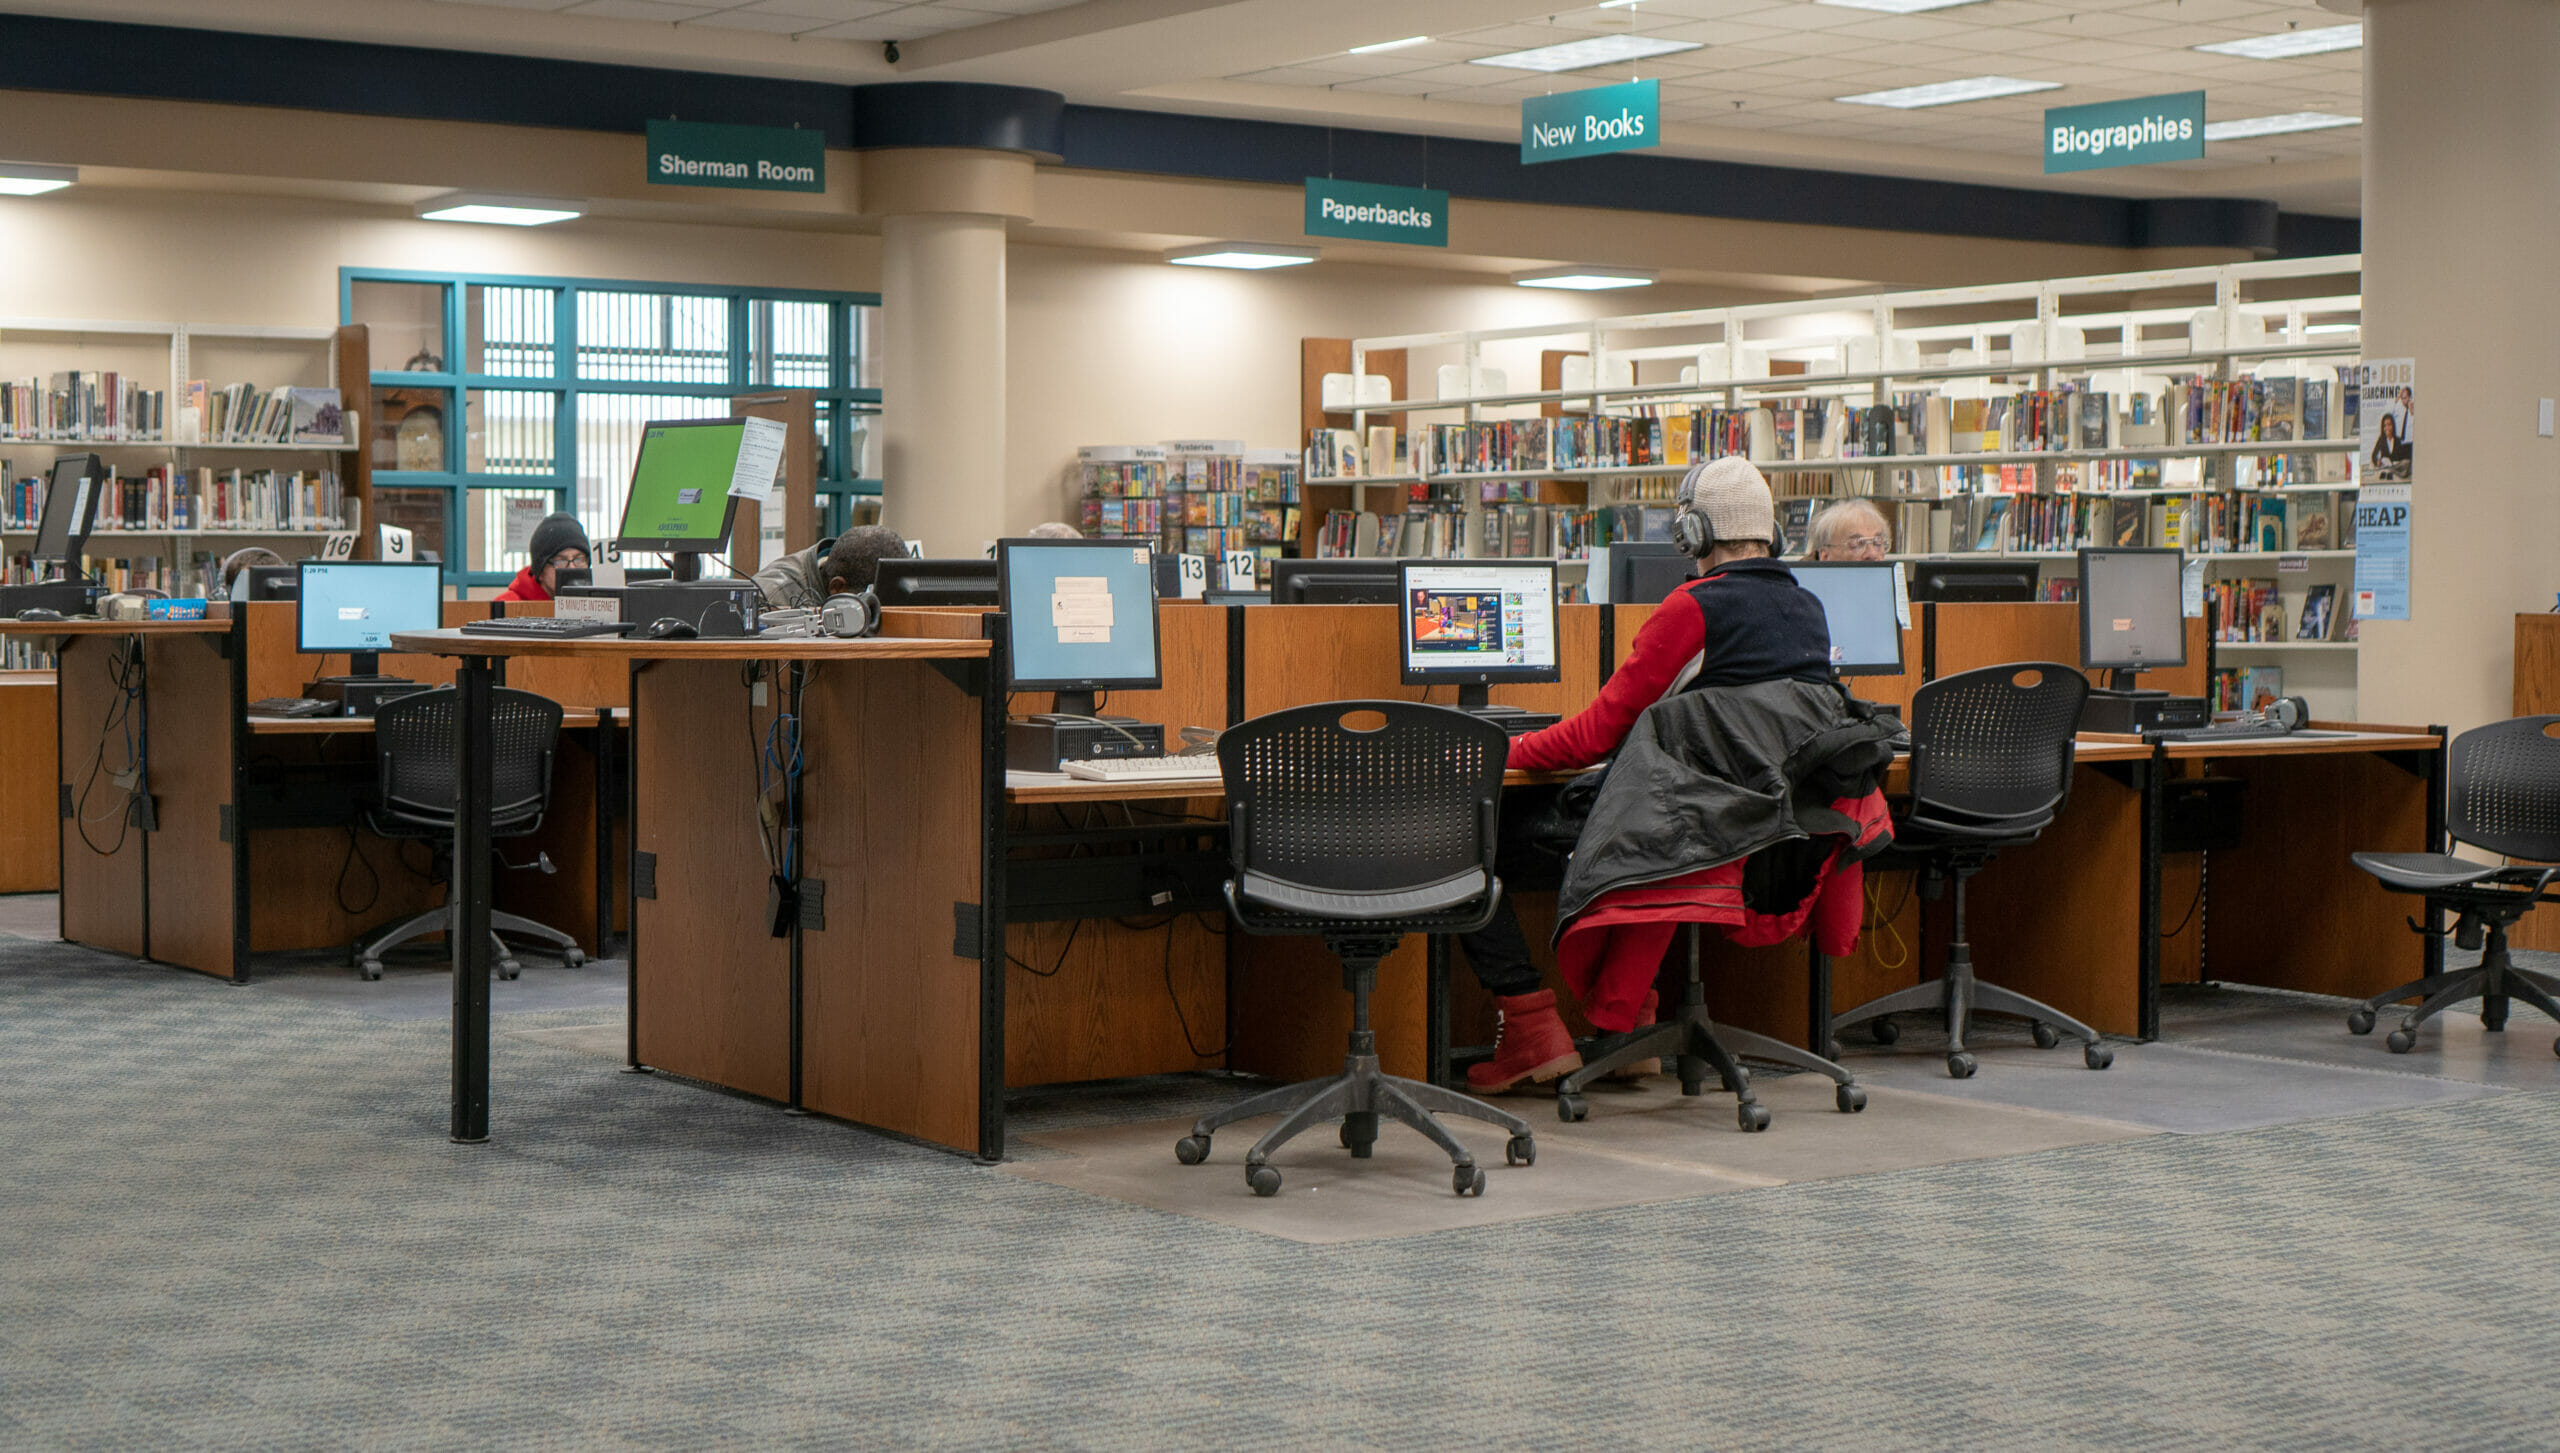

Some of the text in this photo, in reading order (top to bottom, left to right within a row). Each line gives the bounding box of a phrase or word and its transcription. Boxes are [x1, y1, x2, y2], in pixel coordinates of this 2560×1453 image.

[1532, 107, 1645, 149] New Books
[2052, 114, 2193, 155] Biographies
[659, 153, 815, 182] Sherman Room
[1321, 197, 1433, 228] Paperbacks
[2379, 363, 2412, 384] JOB
[2361, 385, 2401, 401] SEARCHING
[1174, 442, 1214, 453] Mysteries
[2358, 506, 2407, 528] HEAP
[327, 534, 353, 557] 16
[390, 533, 404, 554] 9
[592, 541, 621, 565] 15
[1181, 557, 1204, 580] 13
[1229, 554, 1253, 576] 12
[565, 599, 587, 611] MINUTE
[588, 599, 617, 613] INTERNET
